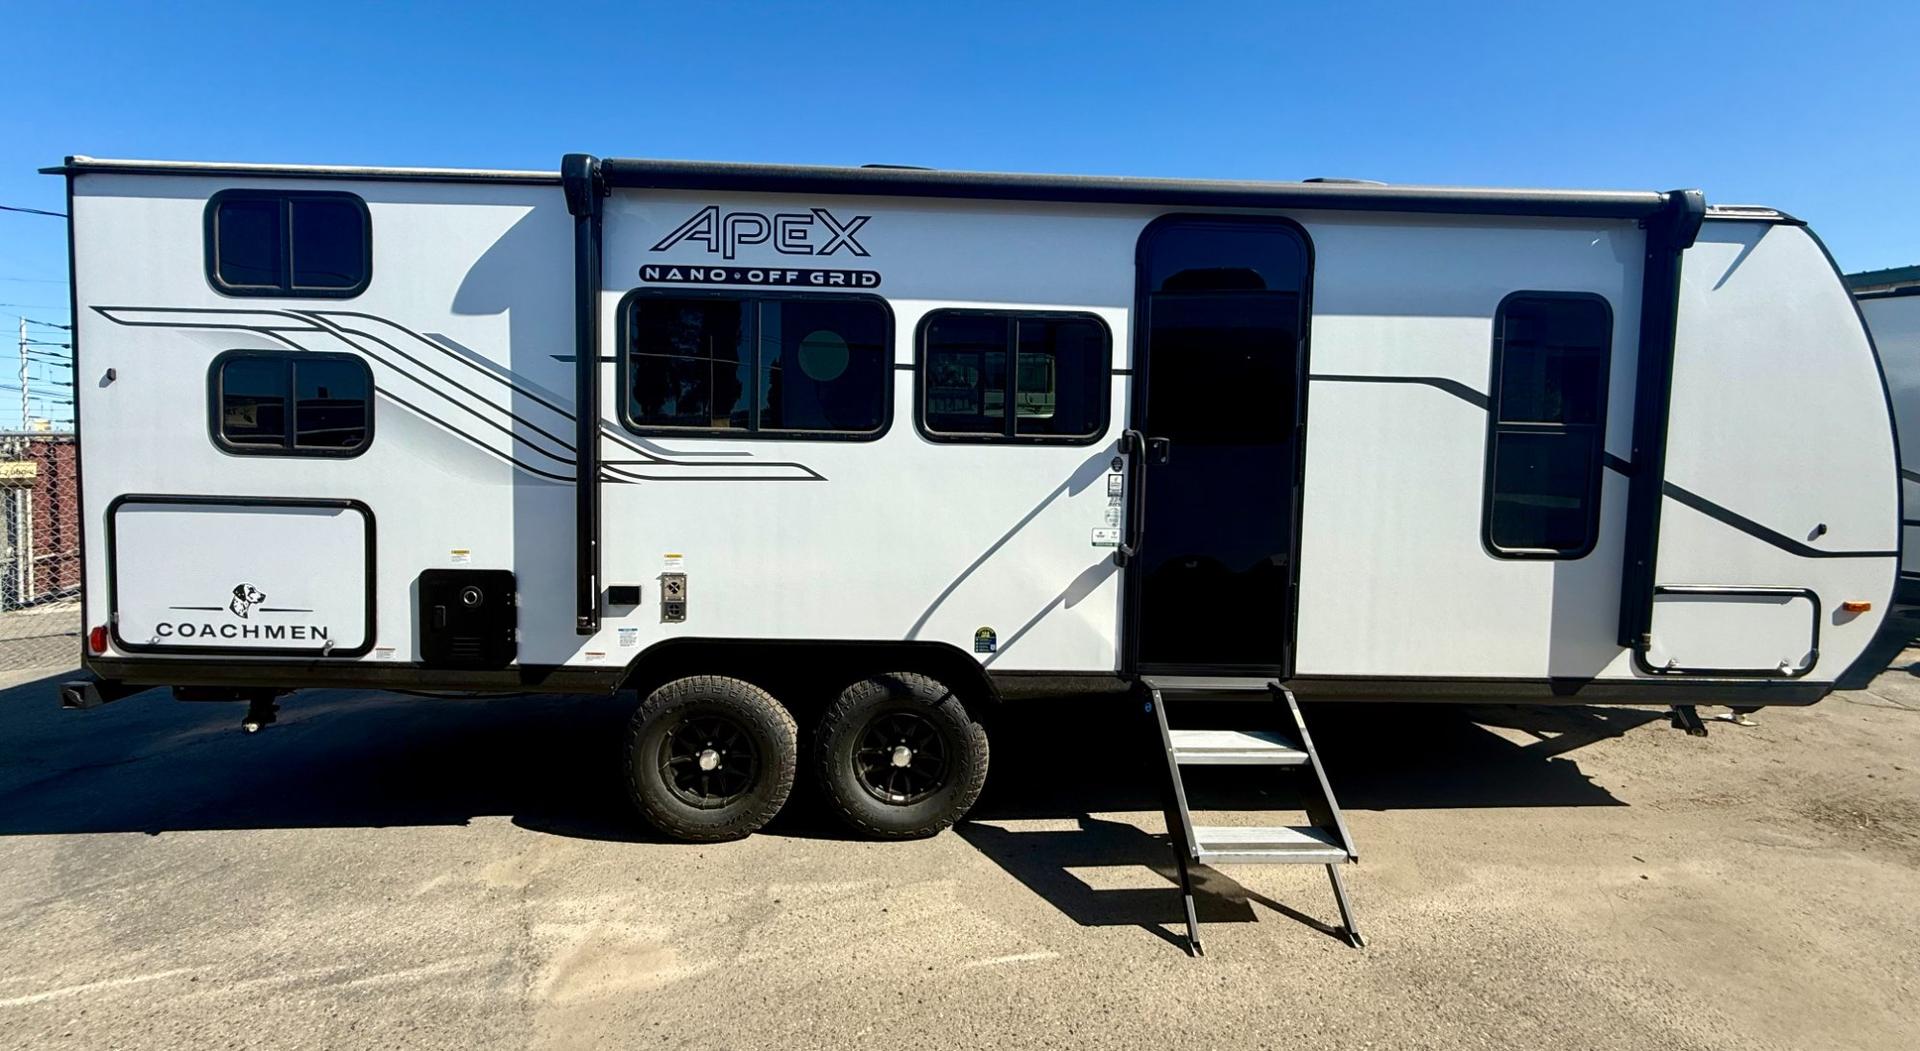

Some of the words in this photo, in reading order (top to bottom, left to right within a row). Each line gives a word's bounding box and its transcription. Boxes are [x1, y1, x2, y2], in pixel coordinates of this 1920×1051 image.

[649, 205, 872, 260] APEX
[645, 267, 727, 281] NANO
[747, 270, 799, 283] OFF
[809, 273, 877, 286] GRID
[156, 622, 328, 640] COACHMEN
